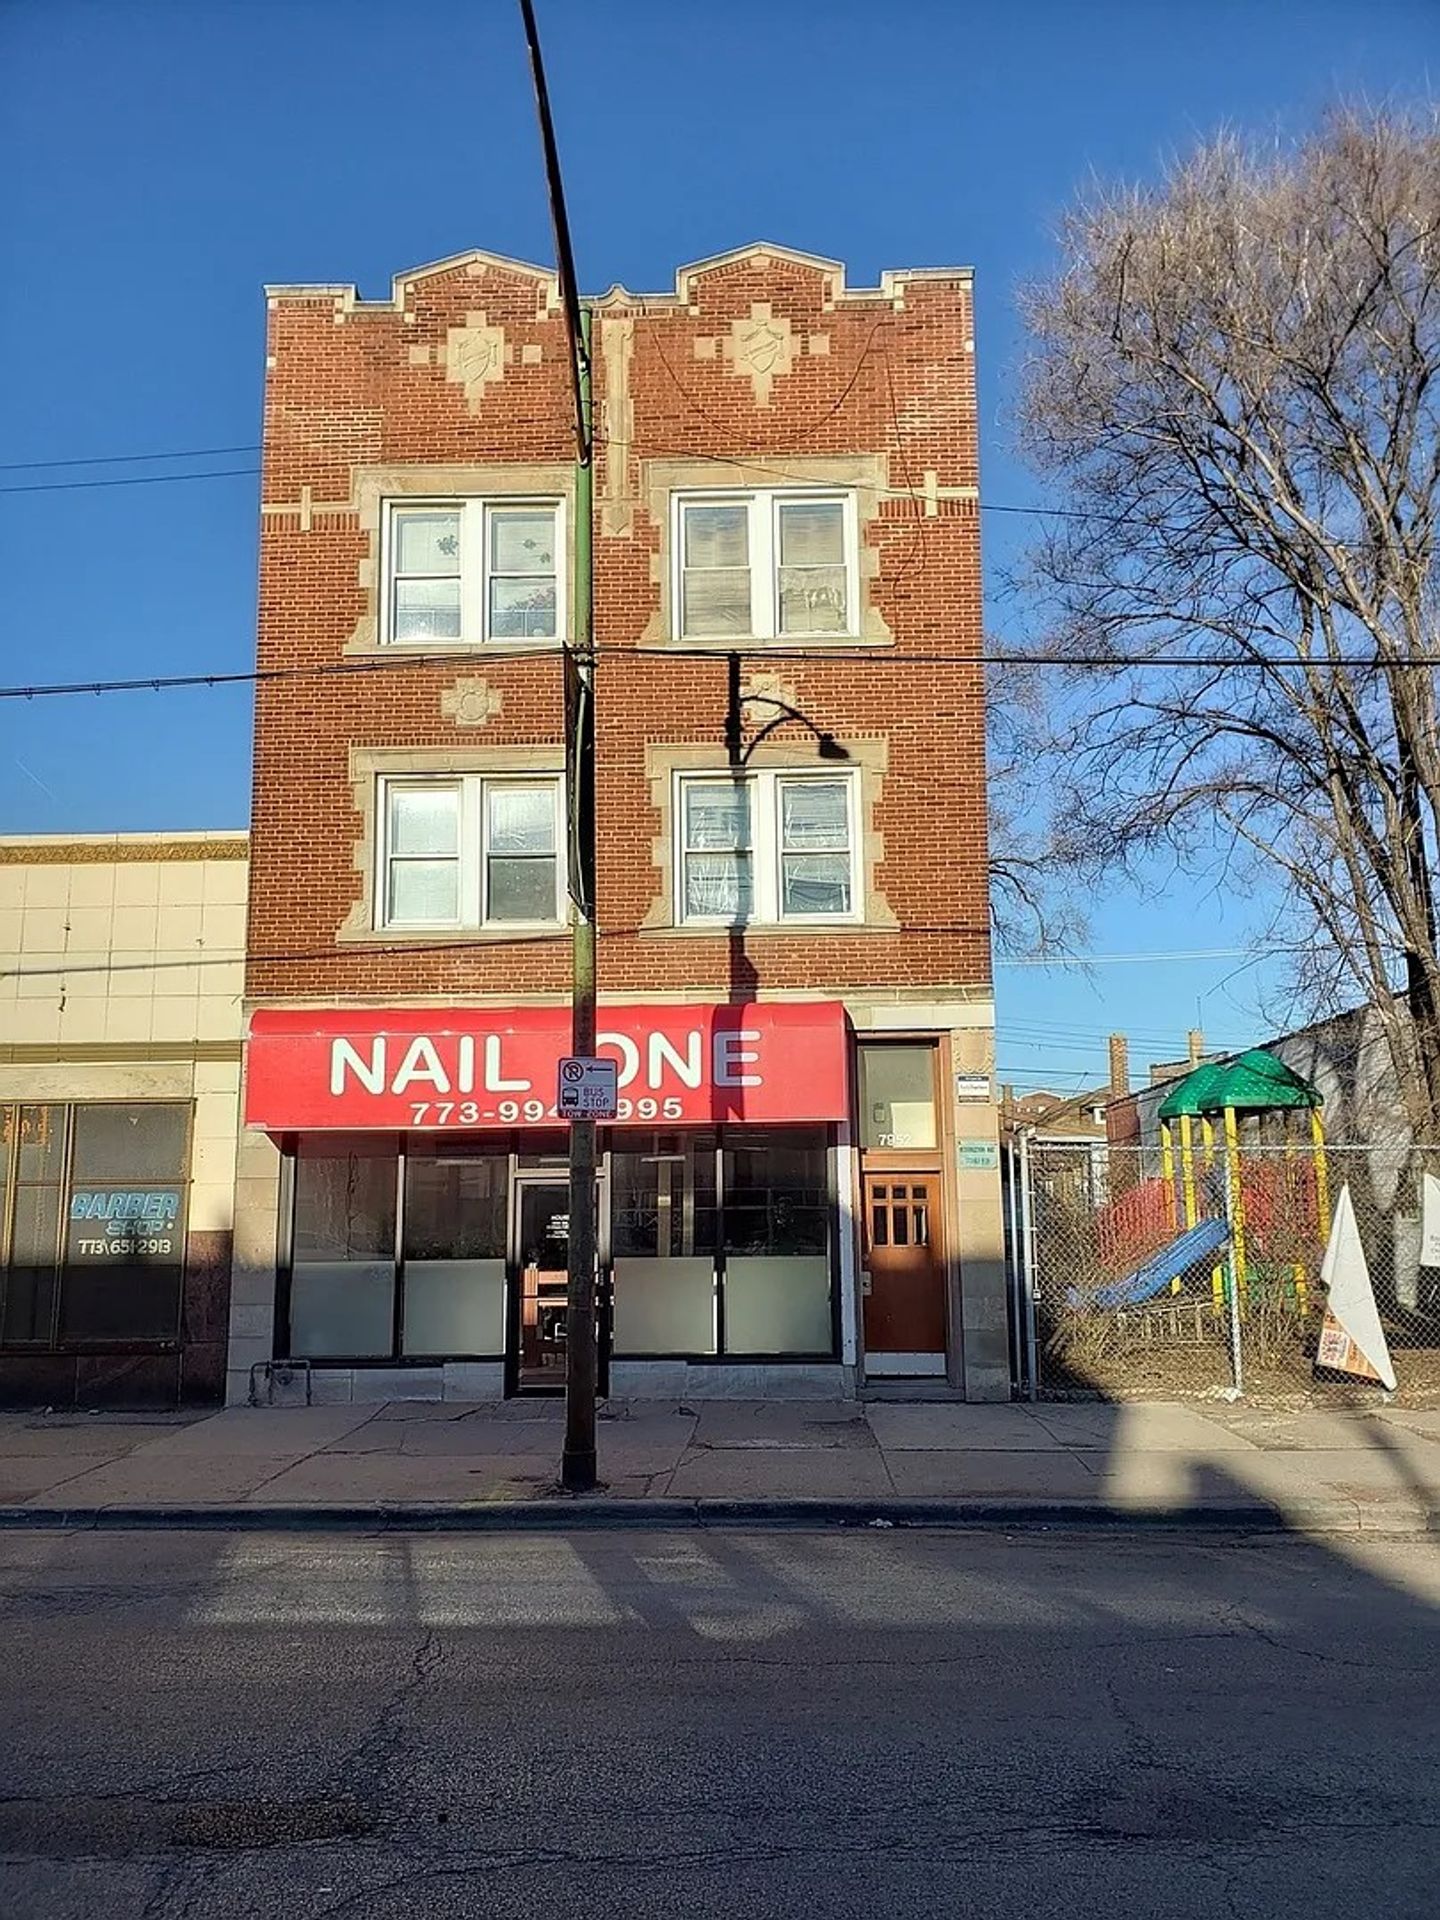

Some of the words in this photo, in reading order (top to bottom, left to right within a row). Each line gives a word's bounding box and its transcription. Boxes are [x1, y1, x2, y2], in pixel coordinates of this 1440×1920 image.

[330, 1034, 532, 1096] NAIL
[596, 1031, 763, 1089] ONE
[583, 1088, 605, 1098] BUS
[583, 1098, 610, 1108] STOP
[70, 1192, 179, 1220] BARBER
